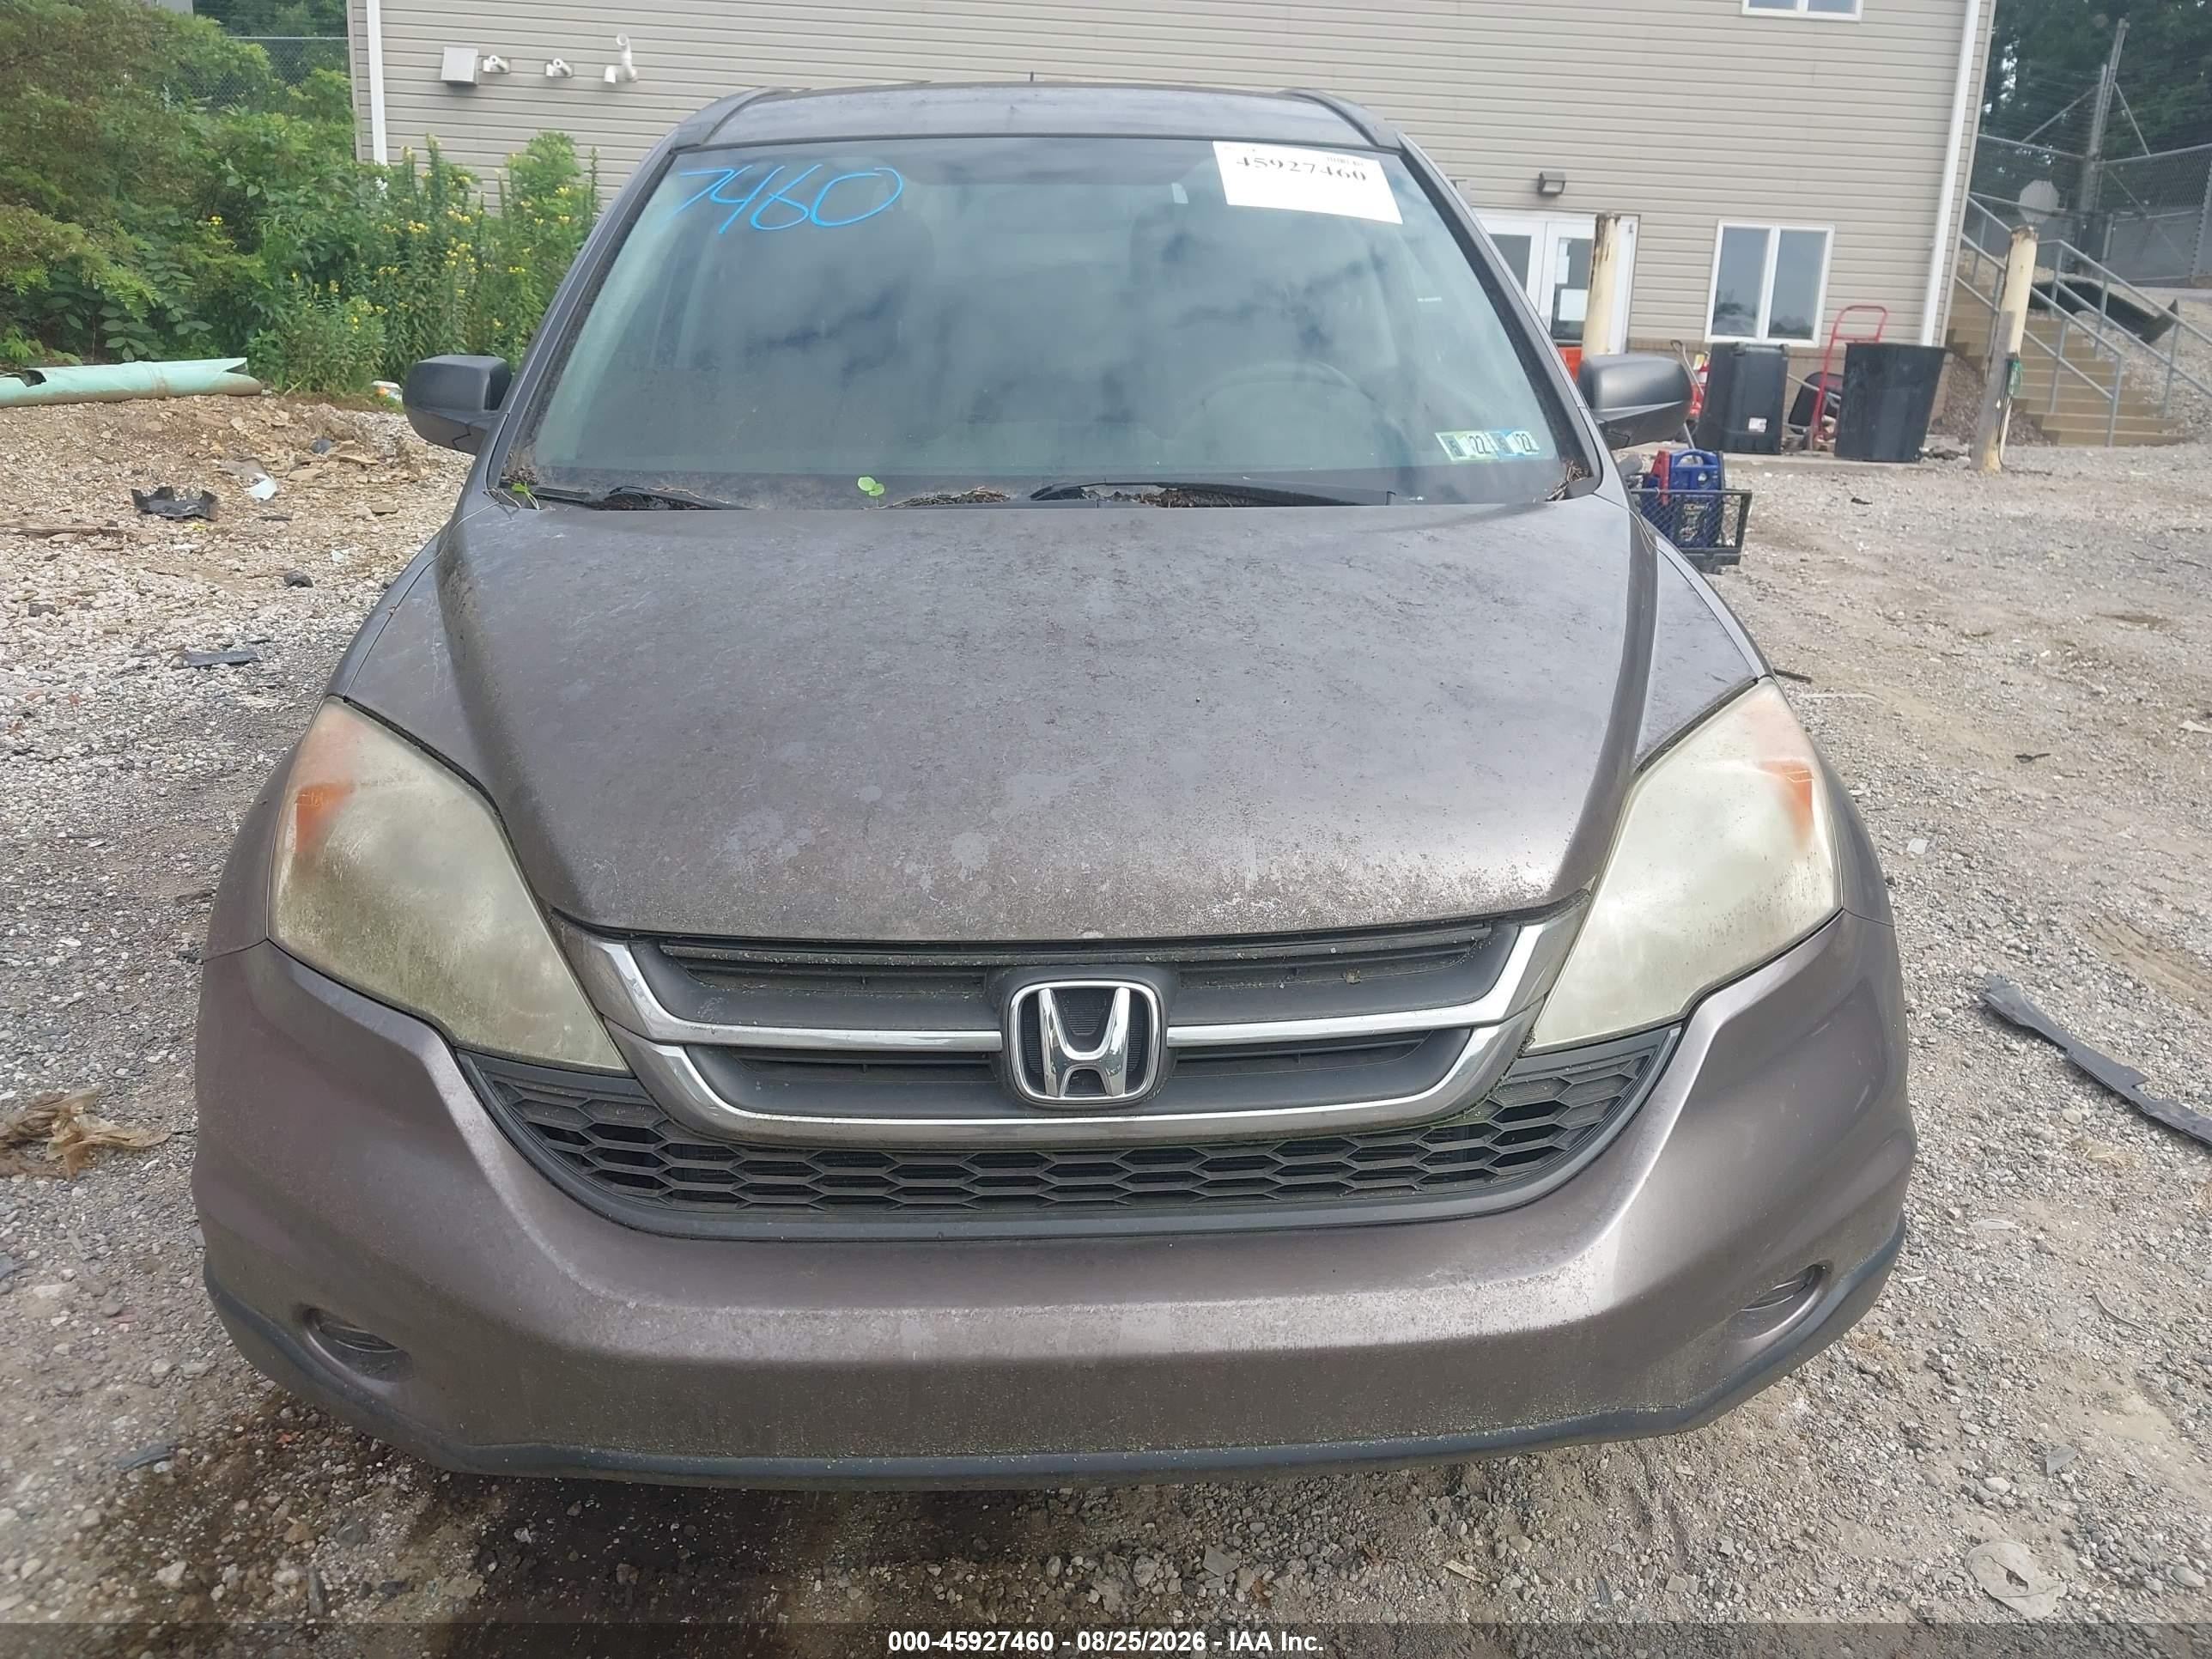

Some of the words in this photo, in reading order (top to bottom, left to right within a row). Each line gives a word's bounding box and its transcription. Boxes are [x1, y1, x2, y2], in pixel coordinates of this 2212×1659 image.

[1236, 155, 1367, 182] 45927460
[661, 164, 903, 234] 7460
[1468, 434, 1492, 454] 22
